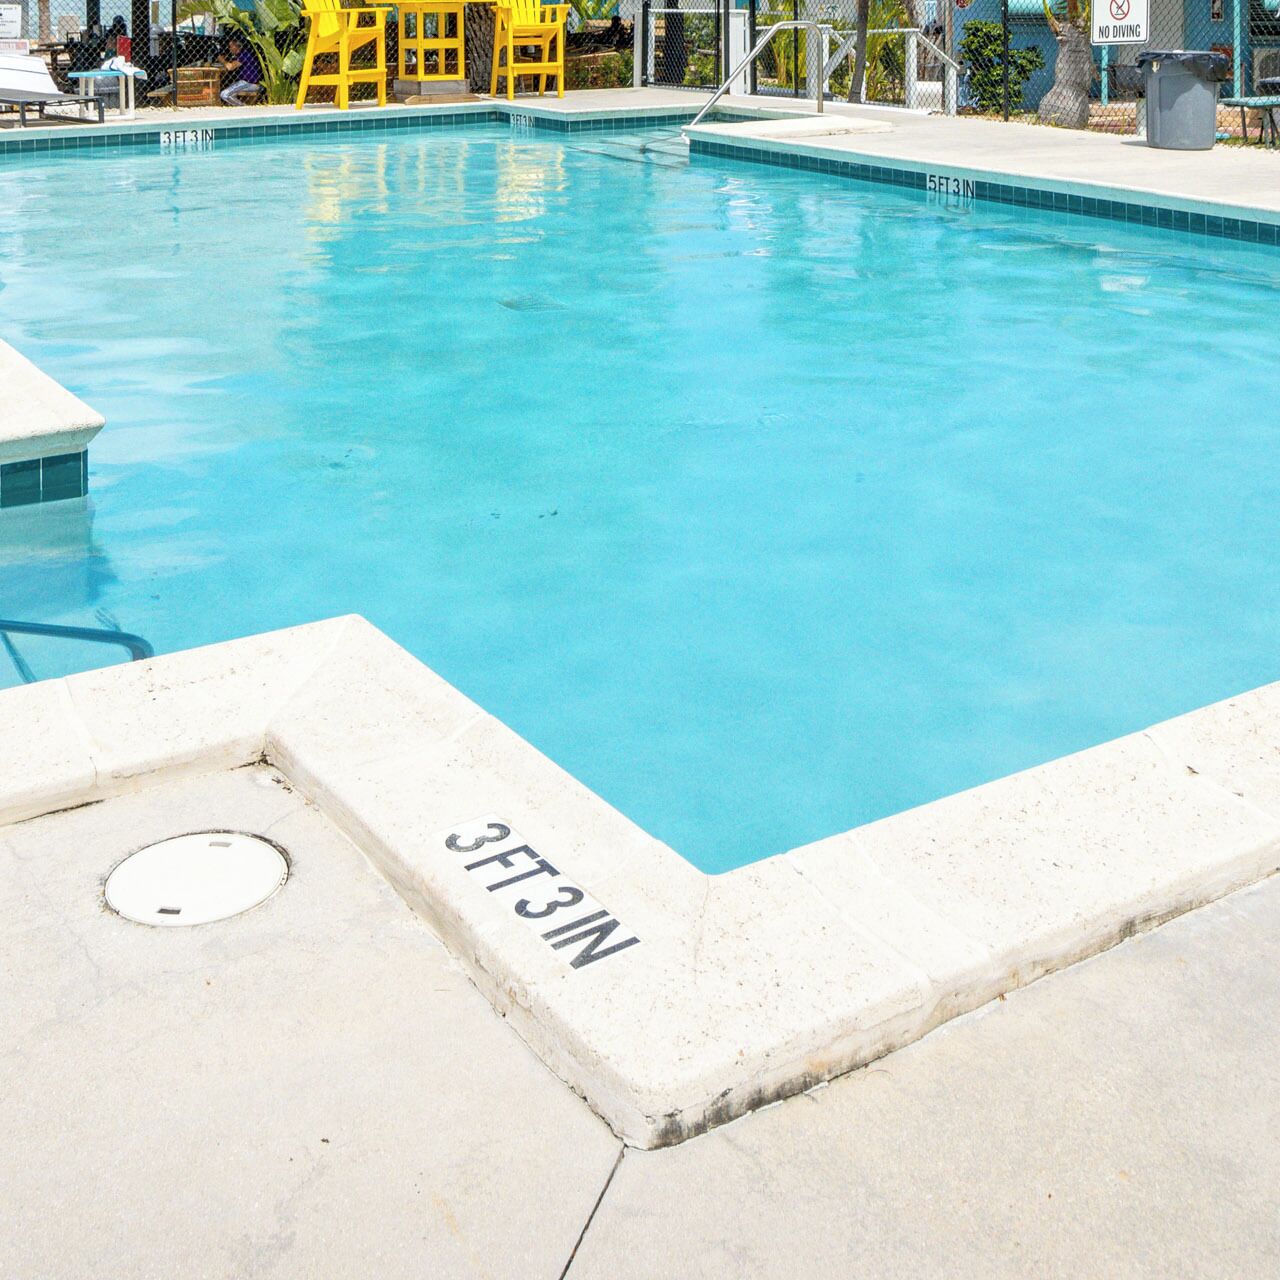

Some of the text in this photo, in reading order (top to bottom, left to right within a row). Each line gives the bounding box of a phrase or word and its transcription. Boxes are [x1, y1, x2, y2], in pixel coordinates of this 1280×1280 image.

[1099, 23, 1141, 39] NO DIVING
[163, 129, 214, 144] 3 FT 3 IN
[928, 174, 975, 198] 5 FT 3 IN
[445, 822, 641, 970] 3 FT 3 IN
